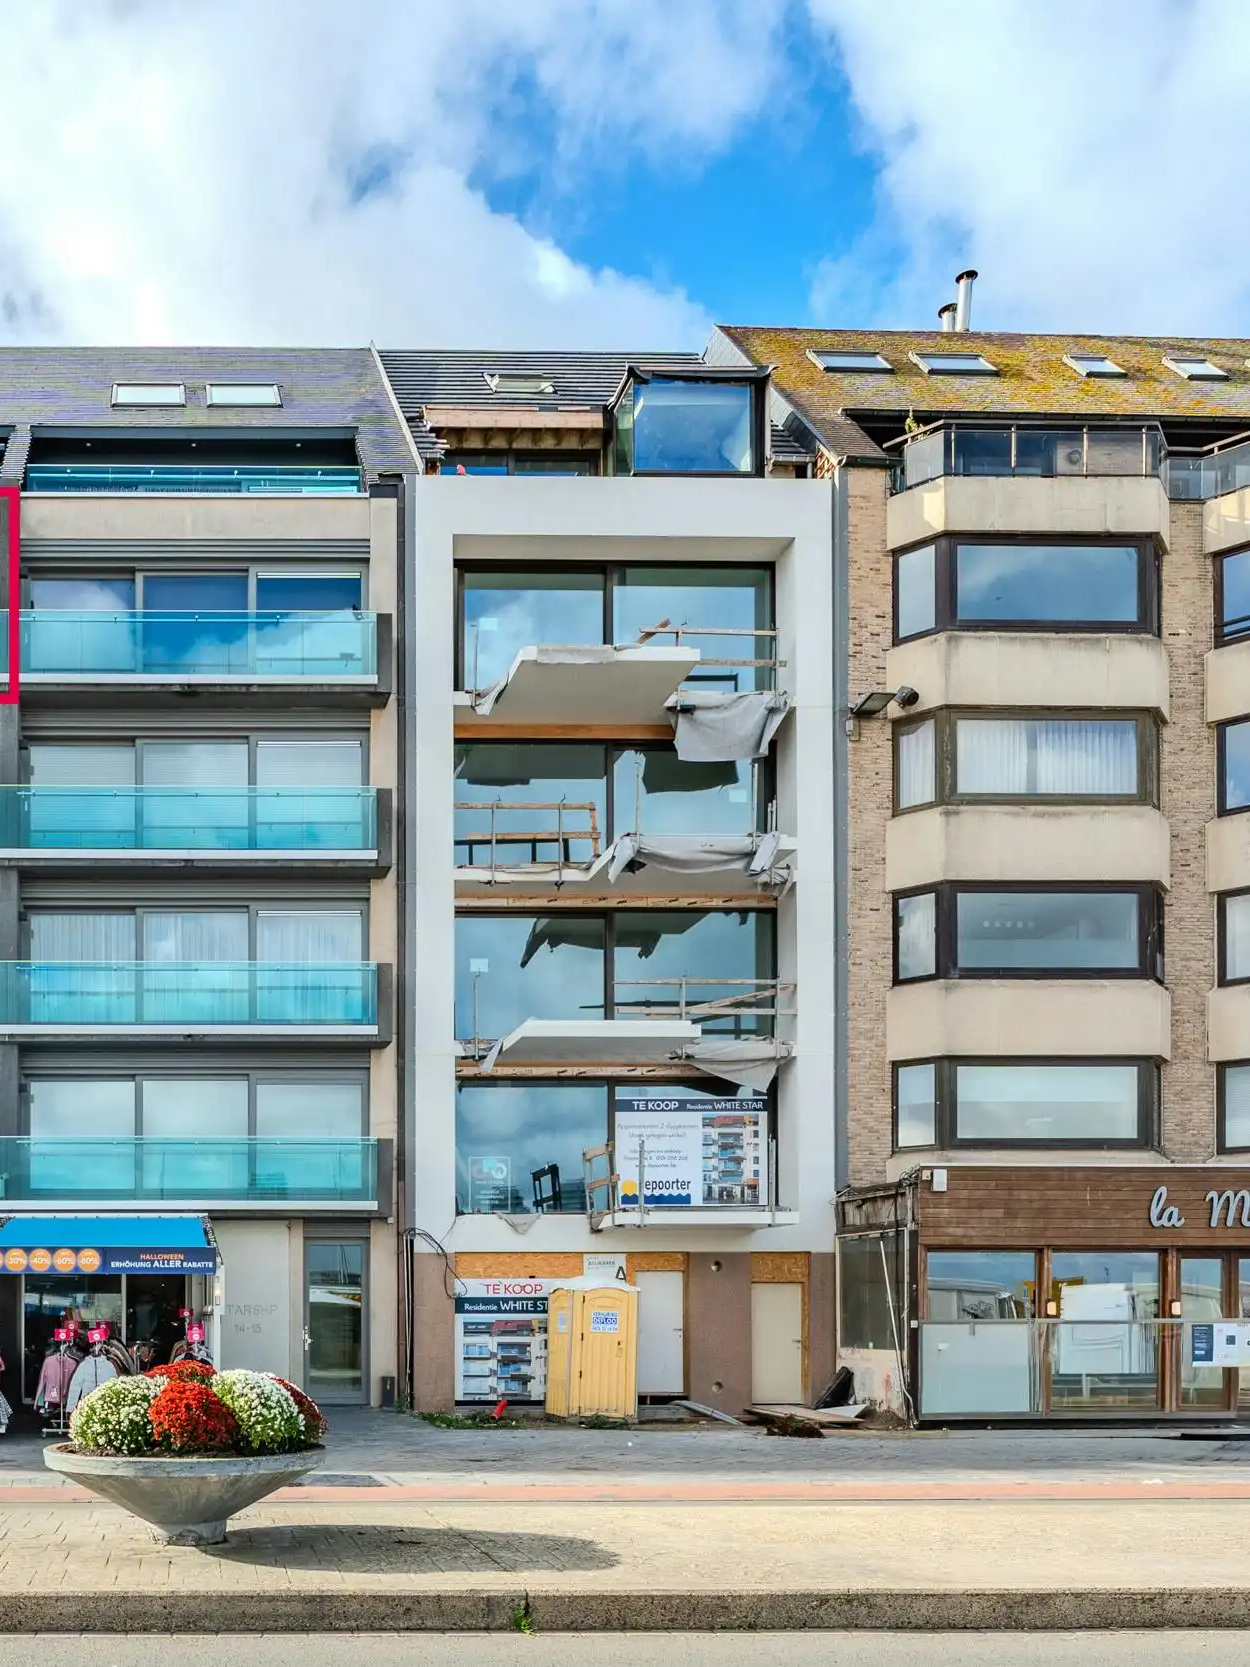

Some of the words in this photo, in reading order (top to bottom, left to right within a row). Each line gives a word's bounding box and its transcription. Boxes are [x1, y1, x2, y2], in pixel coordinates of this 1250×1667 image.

[632, 1101, 646, 1110] TE
[648, 1101, 679, 1110] KOOP
[714, 1101, 740, 1110] WHITE
[743, 1101, 763, 1110] STAR
[644, 1178, 691, 1191] epoorter
[1150, 1186, 1185, 1227] la
[111, 1260, 151, 1268] ERHÖHUNG
[153, 1260, 181, 1268] ALLER
[484, 1284, 500, 1294] TE
[504, 1284, 543, 1295] KOOP
[226, 1303, 279, 1316] TARSHIP
[464, 1302, 498, 1311] Residentie
[500, 1301, 534, 1311] WHITE
